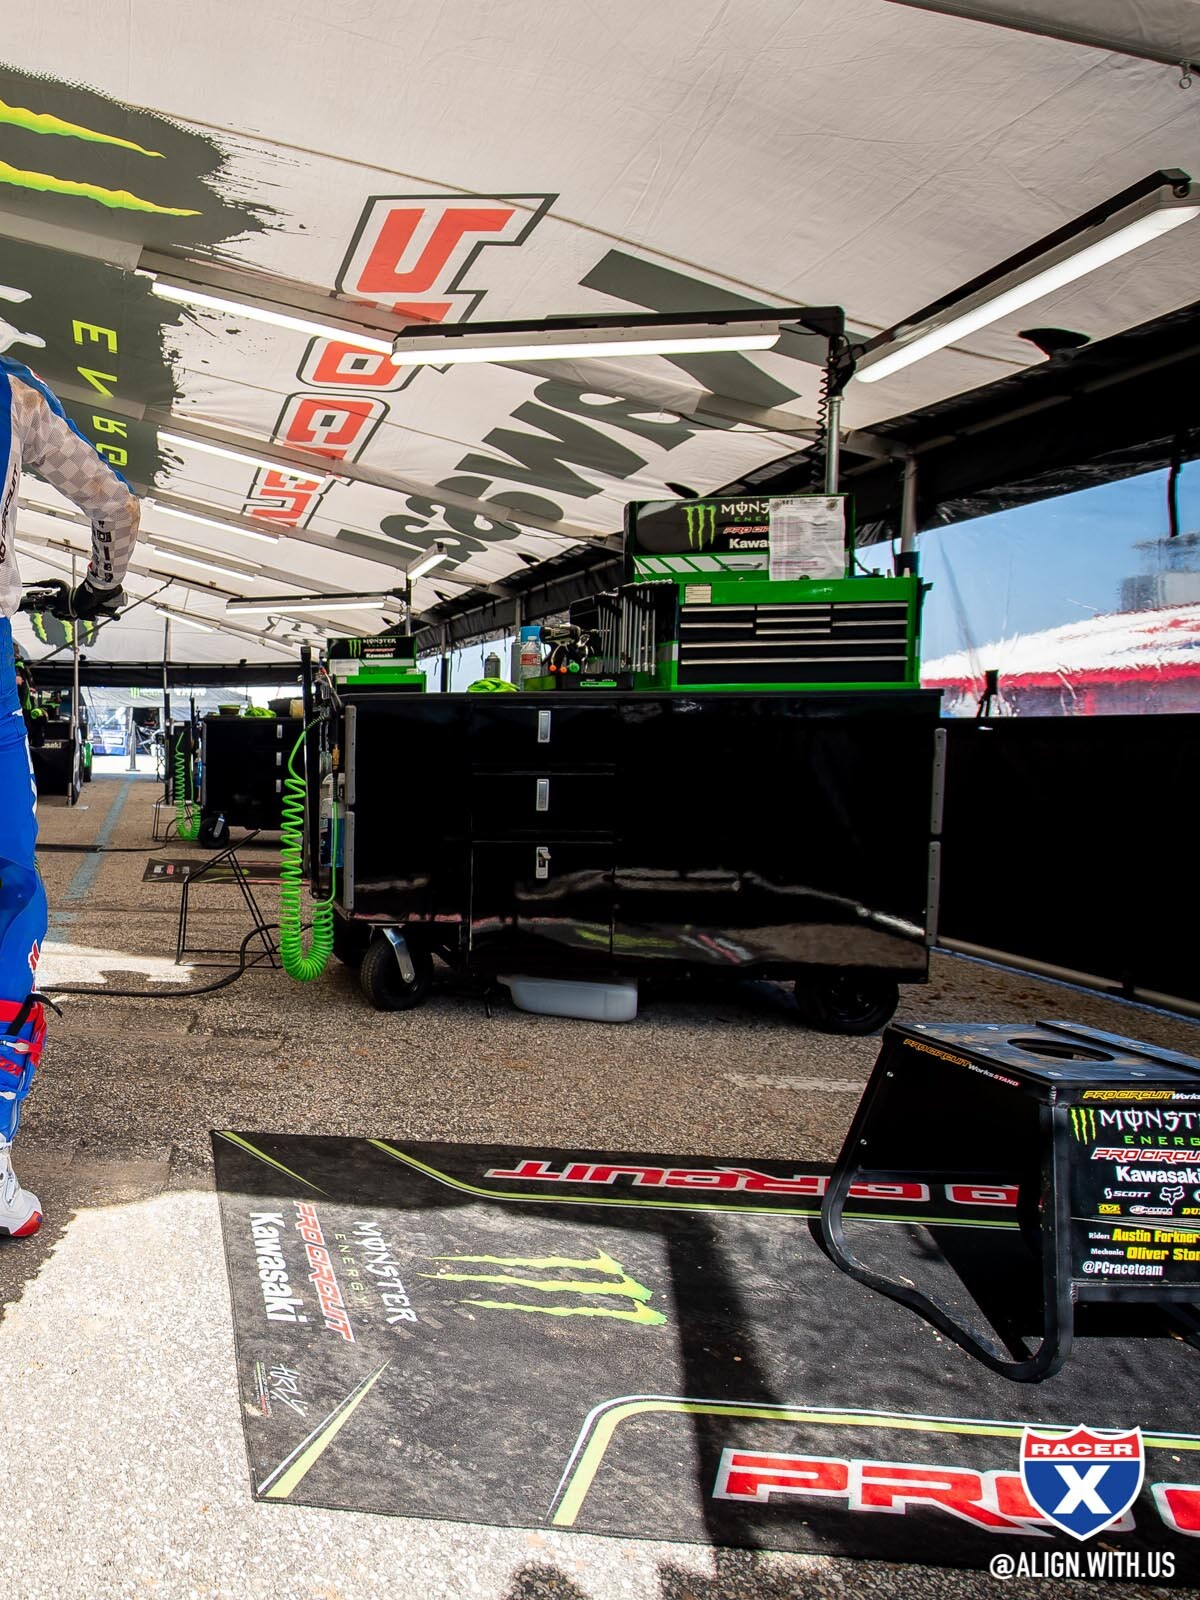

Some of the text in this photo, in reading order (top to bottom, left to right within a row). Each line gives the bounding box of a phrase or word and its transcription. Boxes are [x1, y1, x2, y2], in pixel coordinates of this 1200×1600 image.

[729, 538, 769, 549] Kawa
[1098, 1107, 1200, 1133] MONST
[1090, 1147, 1141, 1163] PRO
[1115, 1165, 1200, 1184] Kawasaki
[1112, 1190, 1152, 1199] SCOTT
[1112, 1228, 1152, 1243] Austin
[1154, 1230, 1199, 1243] Forkner
[1126, 1246, 1170, 1260] Oliver
[250, 1212, 309, 1323] Kawasaki
[293, 1201, 356, 1343] PRO CIRCUIT
[352, 1221, 419, 1324] MONSTER
[1082, 1260, 1163, 1276] @PCraceteam
